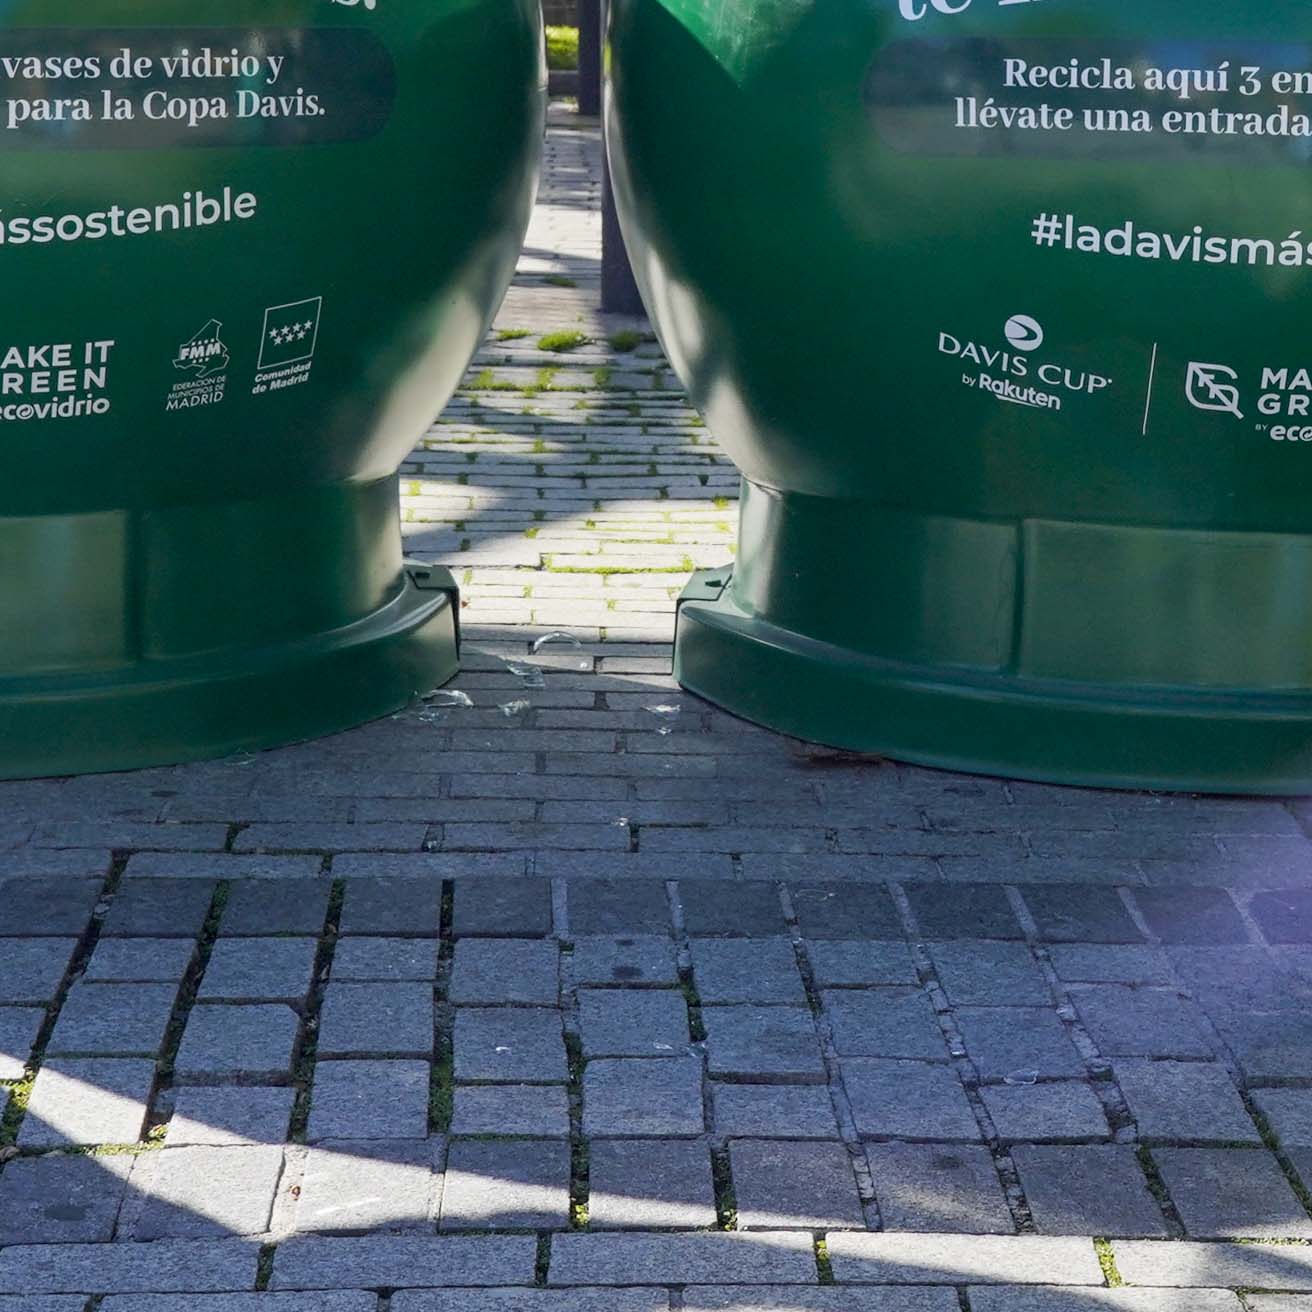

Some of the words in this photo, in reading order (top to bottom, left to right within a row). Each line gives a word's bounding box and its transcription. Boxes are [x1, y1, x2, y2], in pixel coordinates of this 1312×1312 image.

[109, 48, 153, 79] de
[160, 48, 259, 78] vidrio
[265, 56, 284, 85] y
[1003, 57, 1135, 90] Recicla
[1143, 60, 1229, 100] aquí
[1239, 66, 1262, 95] 3
[6, 99, 93, 129] para
[101, 90, 135, 121] la
[142, 91, 229, 127] Copa
[236, 88, 326, 118] Davis.
[954, 97, 1073, 130] llévate
[1082, 109, 1153, 133] una
[1161, 105, 1312, 137] entrada
[84, 340, 115, 364] IT
[180, 341, 221, 361] FMM
[938, 331, 1028, 376] DAVIS
[1038, 364, 1108, 394] CUP
[252, 383, 266, 394] de
[270, 372, 309, 391] Madrid
[254, 361, 312, 382] Comunidad
[166, 391, 223, 411] MADRID
[962, 373, 976, 387] by
[979, 373, 1061, 410] Rakuten
